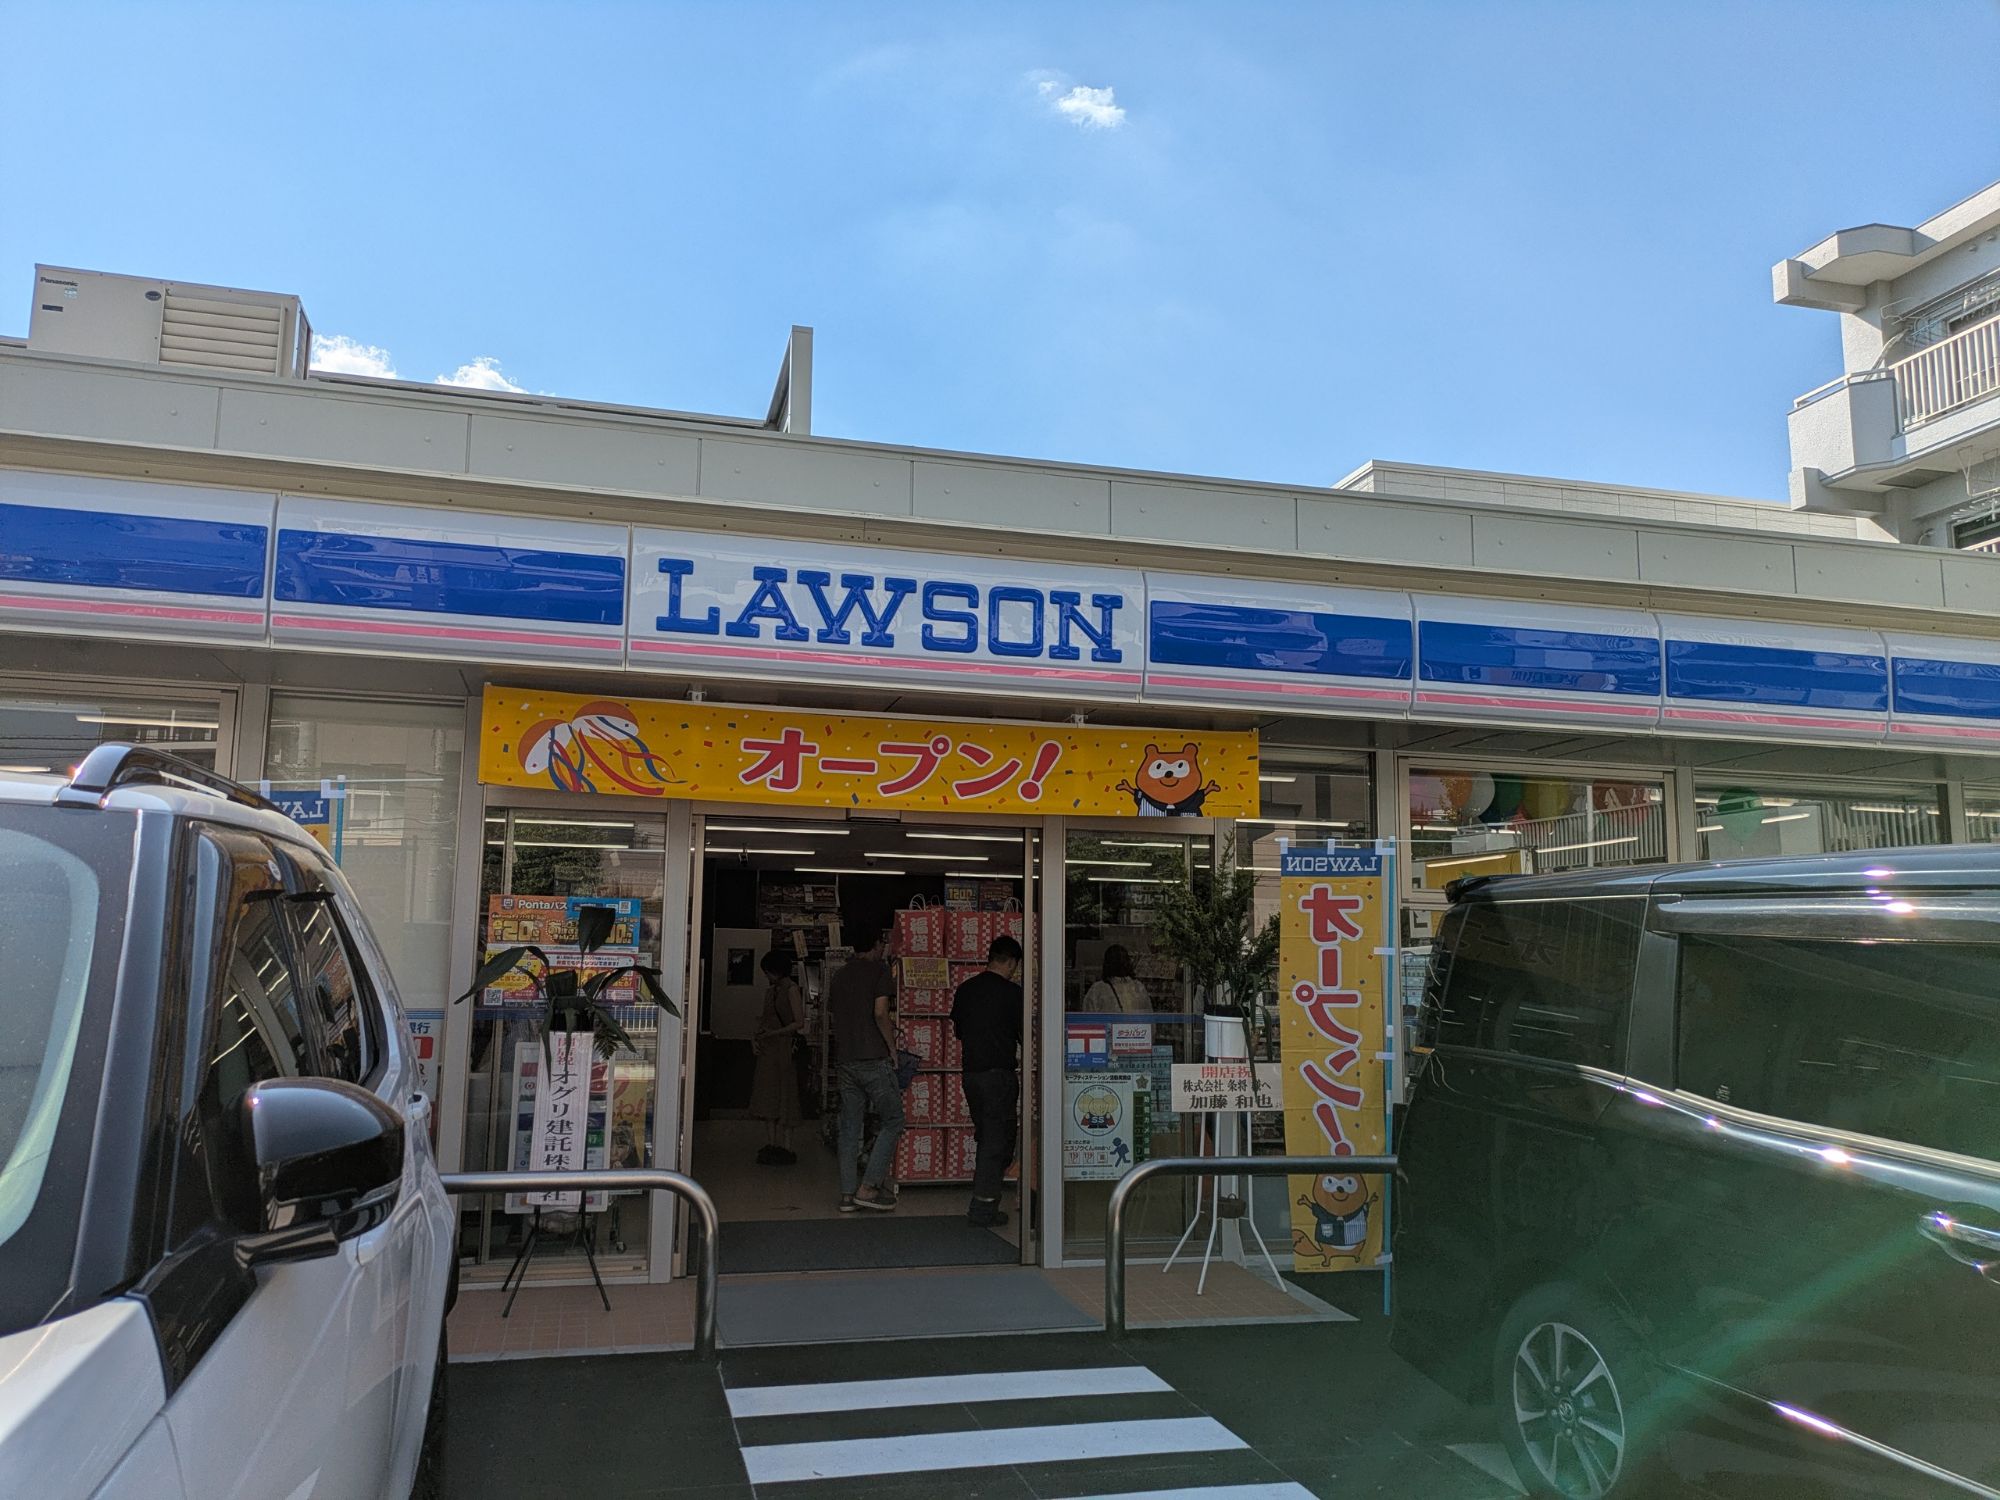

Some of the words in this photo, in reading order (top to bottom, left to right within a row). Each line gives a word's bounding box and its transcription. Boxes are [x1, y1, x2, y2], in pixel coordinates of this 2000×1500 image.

[40, 276, 79, 287] Panasonic
[656, 557, 1123, 663] LAWSON
[738, 727, 1062, 803] オープン!
[1183, 1079, 1224, 1092] 株式会社
[1189, 1094, 1228, 1109] 加藤
